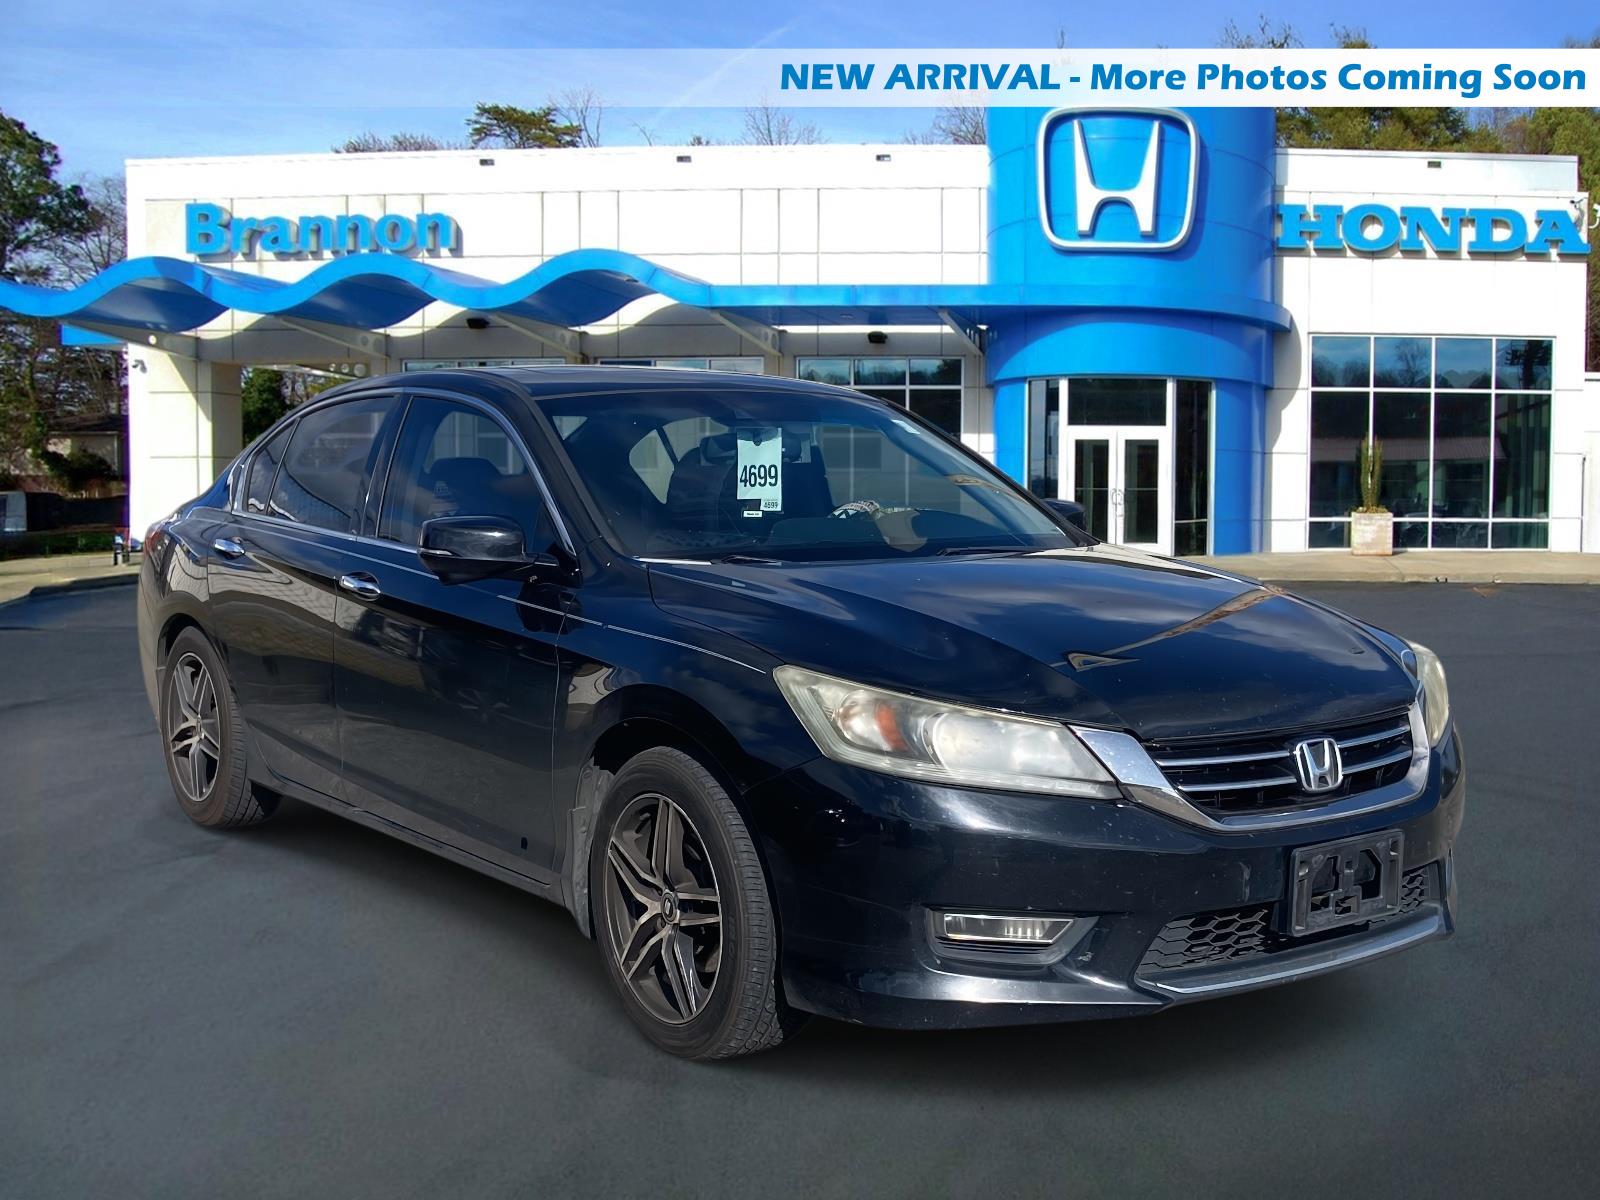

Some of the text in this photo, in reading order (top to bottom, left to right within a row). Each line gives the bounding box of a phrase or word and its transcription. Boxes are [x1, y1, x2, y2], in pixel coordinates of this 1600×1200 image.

[185, 202, 454, 255] Brannon
[1276, 203, 1592, 255] HONDA
[740, 464, 778, 488] 4699
